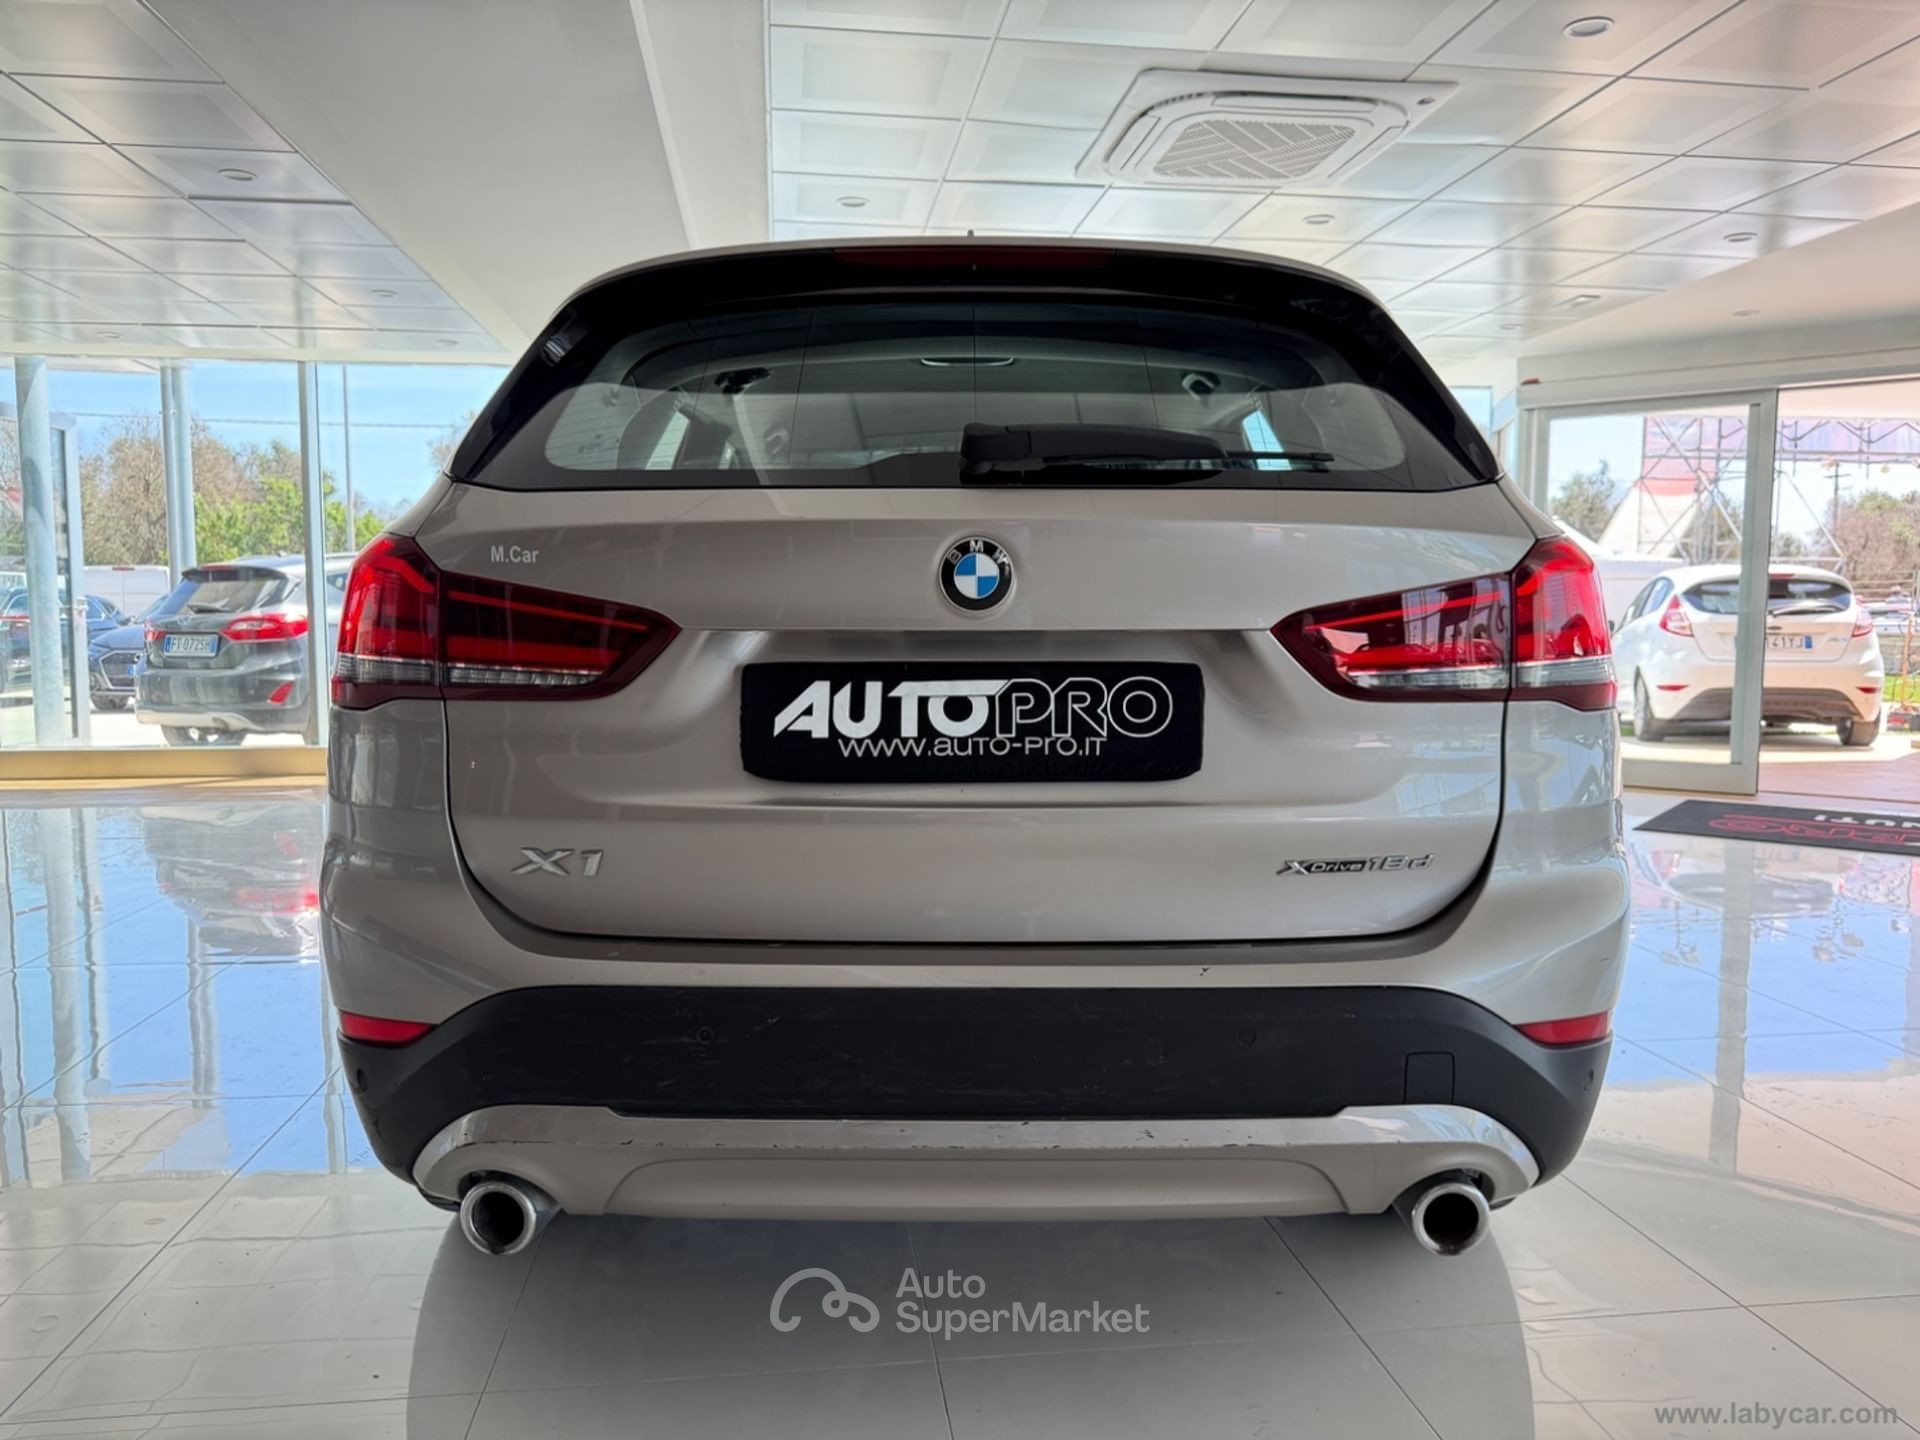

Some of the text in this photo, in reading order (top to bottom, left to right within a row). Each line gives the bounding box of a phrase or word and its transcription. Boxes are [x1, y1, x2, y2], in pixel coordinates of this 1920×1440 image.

[490, 544, 539, 563] M.Car
[946, 539, 1010, 565] BMW
[773, 677, 1173, 738] AUTOPRO
[510, 847, 604, 876] X1
